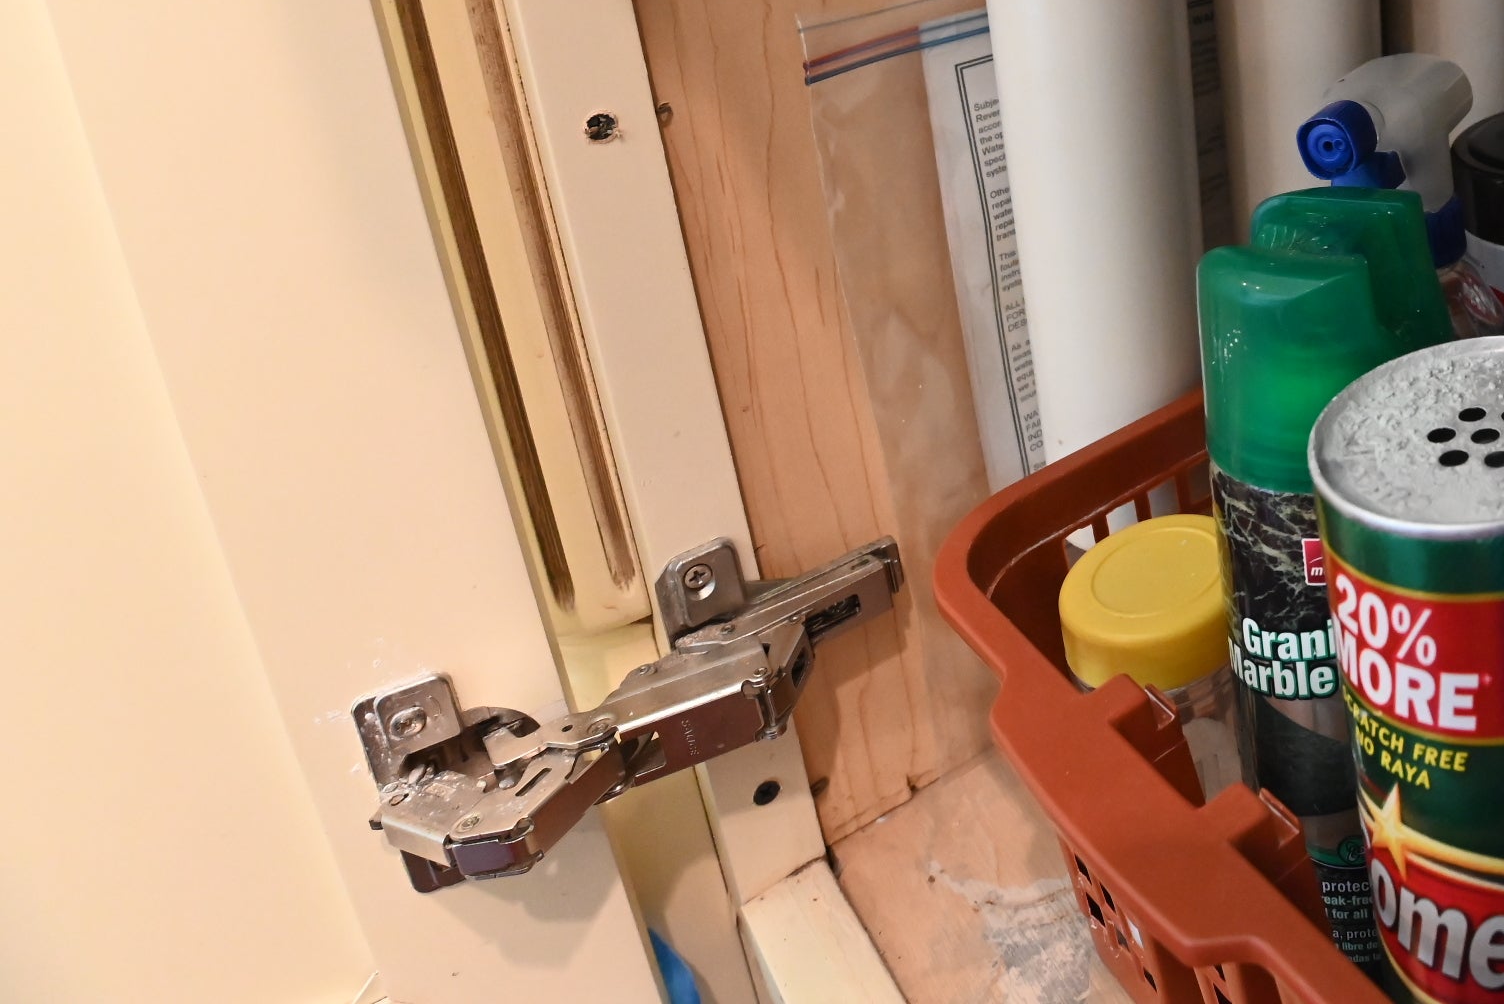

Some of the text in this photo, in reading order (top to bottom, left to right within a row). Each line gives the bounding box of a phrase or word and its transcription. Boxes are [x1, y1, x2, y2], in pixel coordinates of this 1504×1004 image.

[1335, 573, 1437, 666] 20%
[1227, 636, 1335, 697] Marble
[1333, 612, 1480, 732] MORE
[1355, 725, 1431, 790] NO RAYA
[1413, 742, 1469, 772] FREE
[1331, 908, 1349, 919] for
[1353, 908, 1368, 919] all
